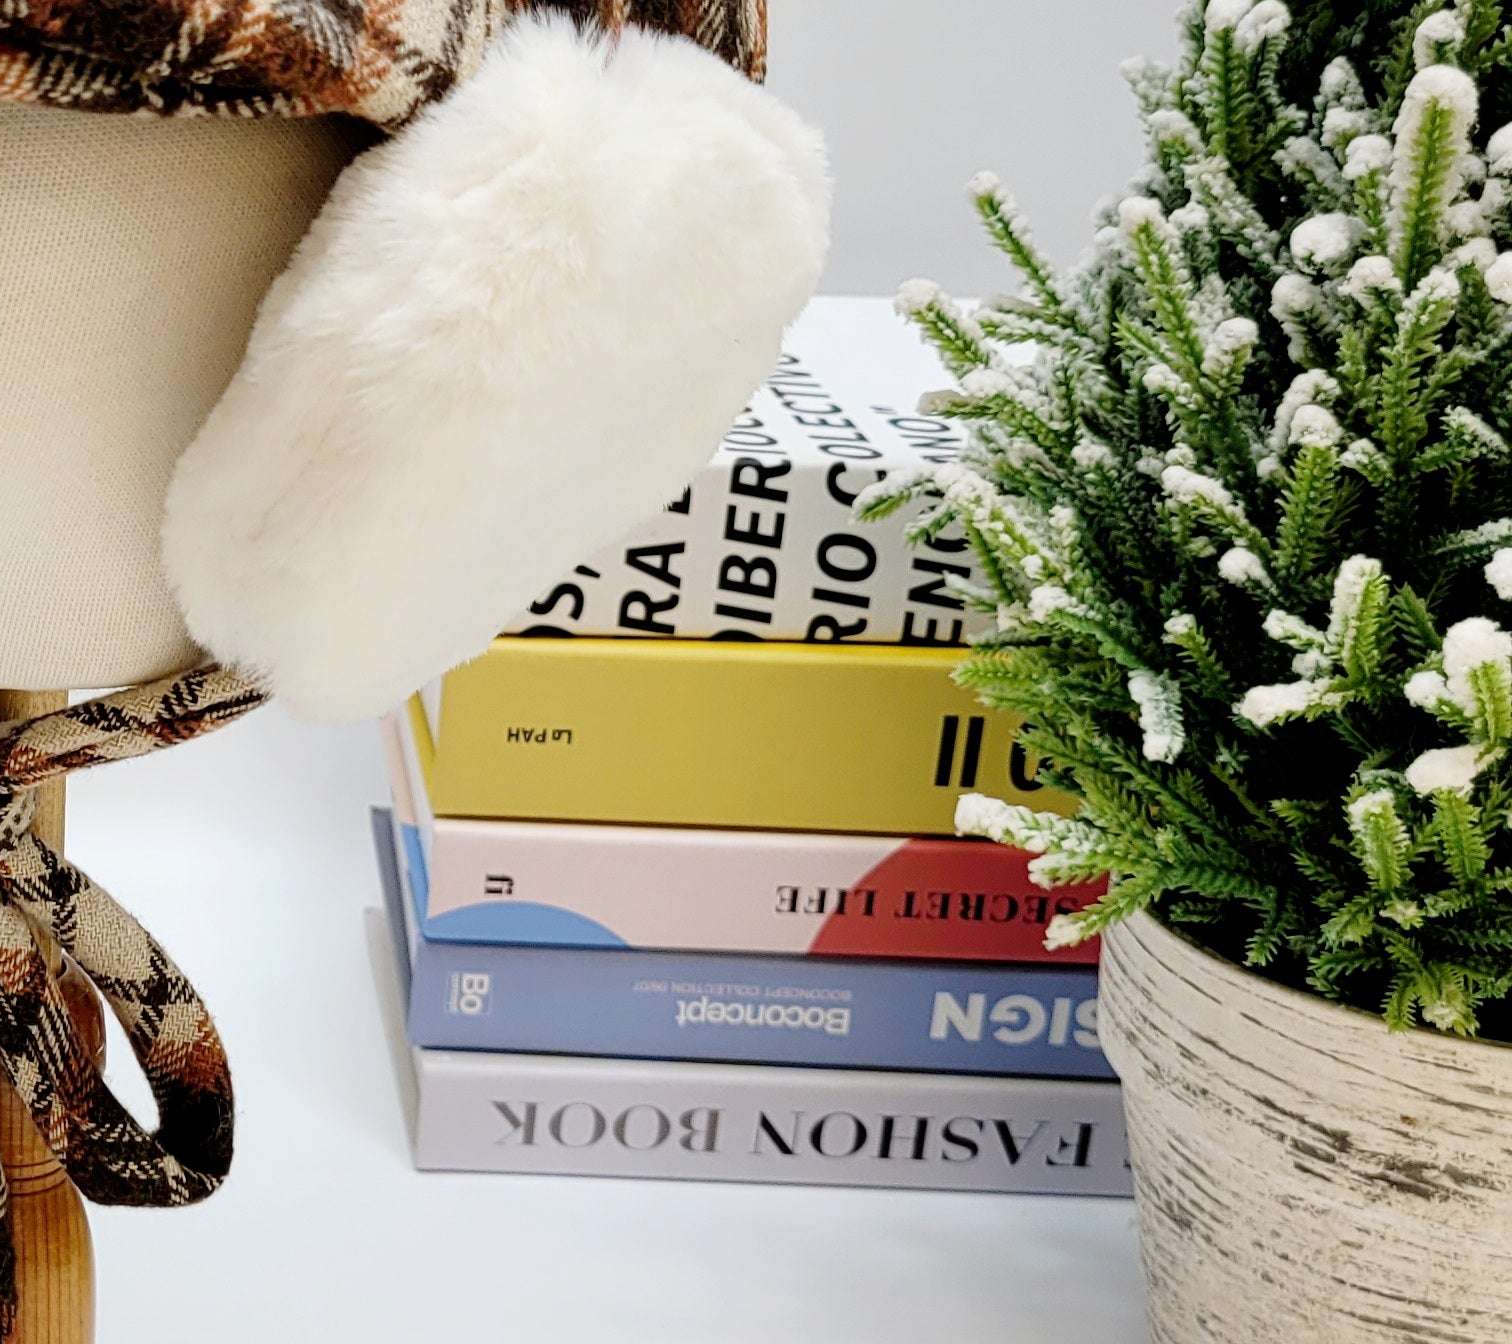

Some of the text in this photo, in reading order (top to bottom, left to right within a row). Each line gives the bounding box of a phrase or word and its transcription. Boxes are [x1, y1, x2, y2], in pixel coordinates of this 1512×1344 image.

[507, 727, 547, 744] PAH
[775, 885, 877, 916] LIFE
[675, 996, 852, 1036] Boconcept
[491, 1100, 724, 1153] BOOK
[753, 1110, 1099, 1167] FASHON
